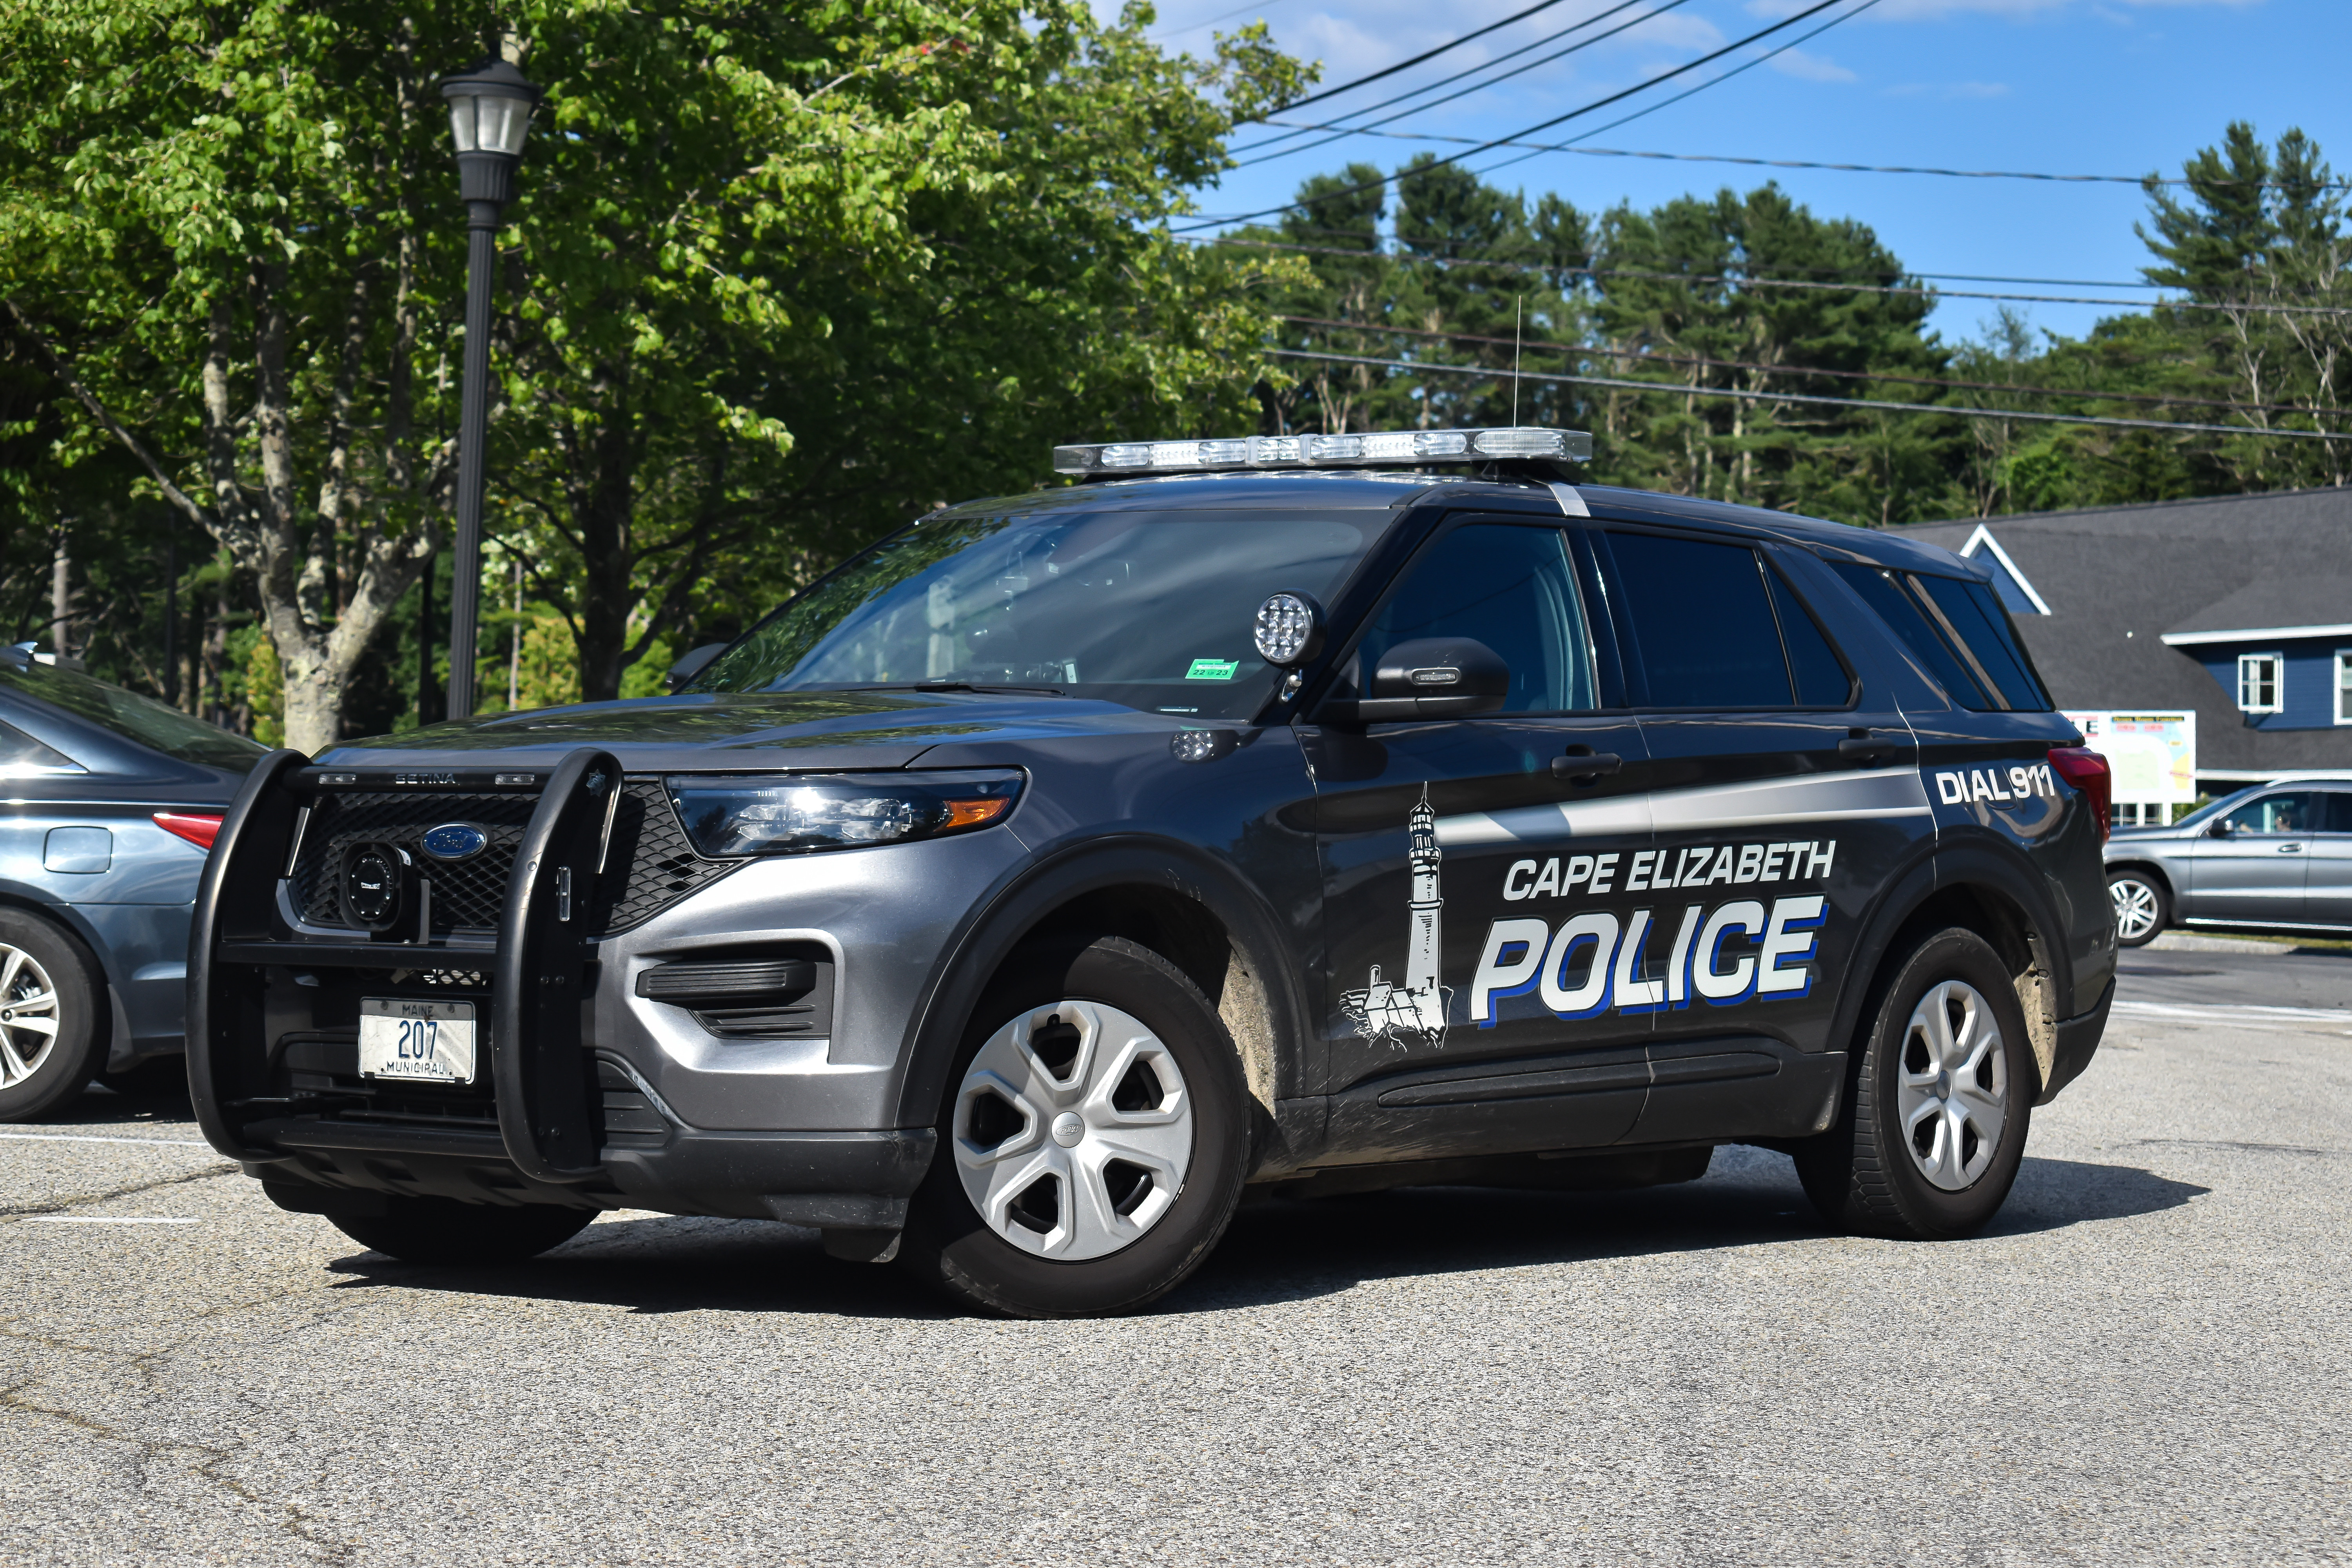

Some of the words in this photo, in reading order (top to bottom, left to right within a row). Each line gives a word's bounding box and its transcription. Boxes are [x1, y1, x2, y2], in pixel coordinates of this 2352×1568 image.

[396, 774, 456, 784] SETINA
[1935, 769, 2011, 805] DIAL
[2009, 765, 2055, 799] 911
[1503, 853, 1619, 900] CAPE
[1625, 840, 1836, 891] ELIZABETH
[1470, 895, 1828, 1026] POLICE
[402, 1004, 433, 1017] MAINE
[398, 1020, 437, 1059] 207
[387, 1060, 443, 1074] MUNICIPAL
